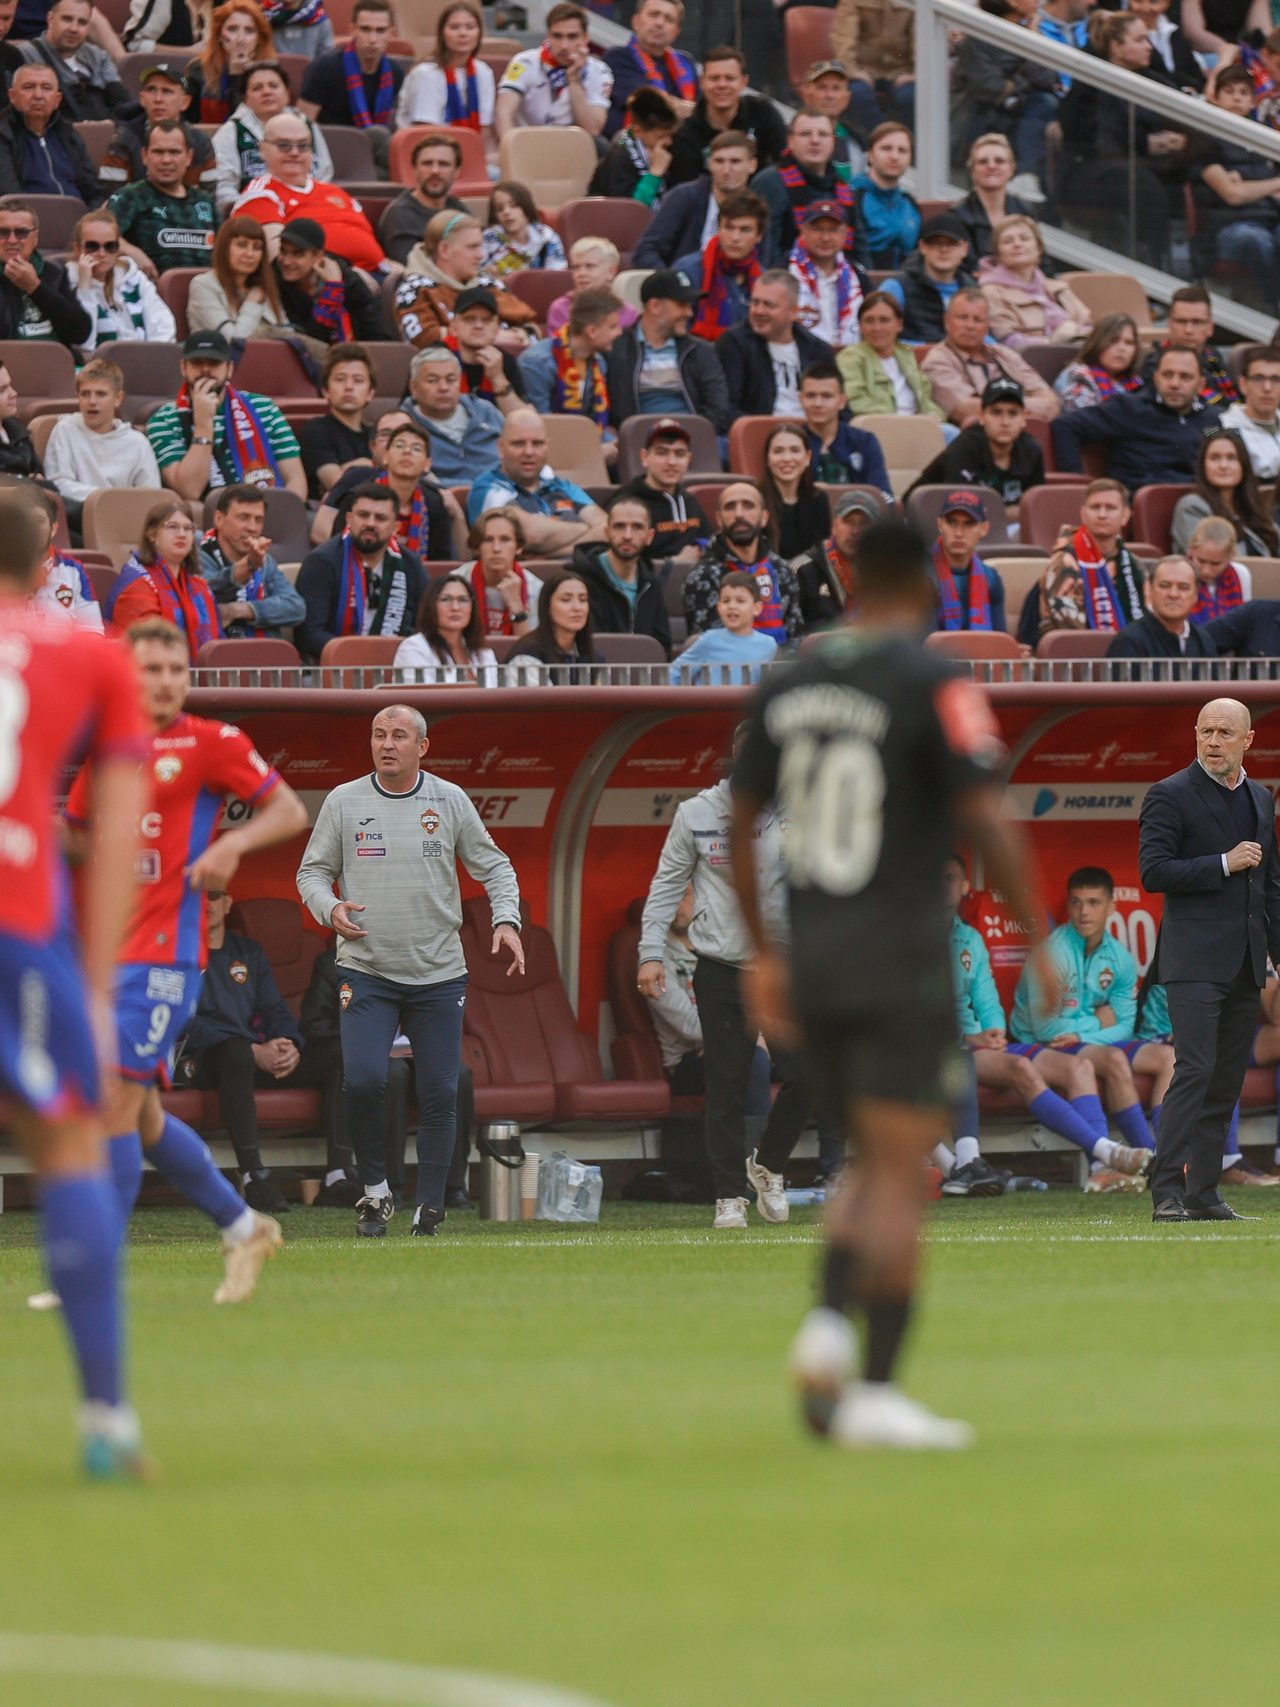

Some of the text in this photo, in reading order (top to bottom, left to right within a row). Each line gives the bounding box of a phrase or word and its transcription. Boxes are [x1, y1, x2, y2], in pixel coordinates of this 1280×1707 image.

[381, 569, 409, 636] РАСНОДАР
[777, 734, 887, 896] 10
[1063, 795, 1135, 808] НОВАТЭК
[365, 833, 383, 841] ПСБ
[146, 1003, 172, 1044] 9
